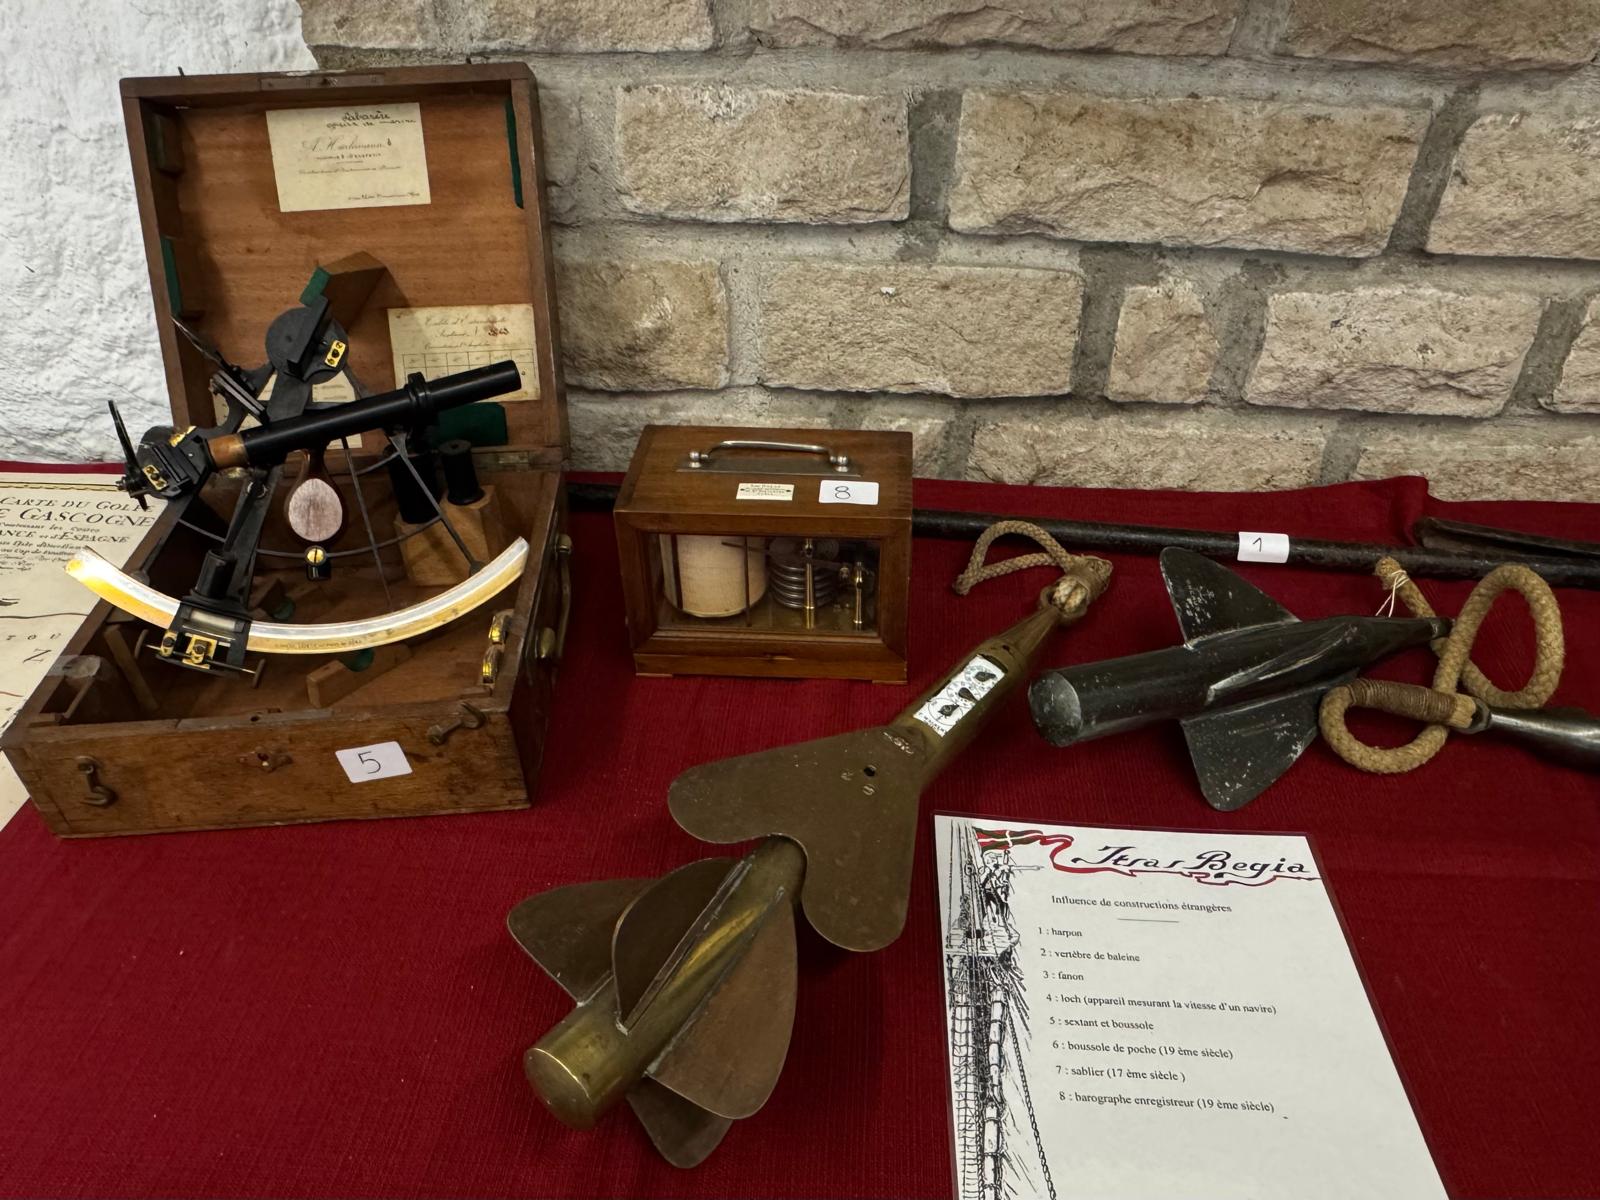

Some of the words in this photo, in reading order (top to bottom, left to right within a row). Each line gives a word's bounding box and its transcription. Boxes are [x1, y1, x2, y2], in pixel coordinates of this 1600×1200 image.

[835, 485, 851, 500] 8
[61, 500, 91, 508] DU
[20, 507, 155, 528] GASCOGNE
[1253, 537, 1262, 552] 1
[358, 750, 382, 775] 5
[1184, 850, 1310, 879] Begia
[1052, 895, 1097, 905] Influence
[1100, 898, 1111, 907] de
[1114, 899, 1179, 910] constructions
[1181, 902, 1232, 913] étrangères
[1051, 928, 1083, 938] harpon
[1054, 950, 1091, 959] vertèbre
[1094, 952, 1105, 960] de
[1107, 952, 1140, 962] baleine
[1058, 971, 1084, 982] fanon
[1061, 994, 1081, 1003] loch
[1083, 995, 1125, 1007] (appareil
[1128, 1000, 1171, 1008] mesurant
[1173, 1000, 1182, 1008] la
[1184, 1001, 1216, 1010] vitesse
[1219, 1002, 1241, 1012] d'un
[1243, 1004, 1276, 1015] navire)
[1064, 1017, 1098, 1027] sextant
[1100, 1020, 1110, 1028] et
[1111, 1020, 1154, 1030] boussole
[1067, 1041, 1110, 1051] boussole
[1113, 1043, 1125, 1052] de
[1127, 1045, 1156, 1055] poche
[1158, 1045, 1175, 1056] (19
[1177, 1047, 1198, 1056] ème
[1201, 1048, 1233, 1060] siècle)
[1071, 1066, 1104, 1077] sablier
[1107, 1069, 1122, 1079] (17
[1126, 1070, 1147, 1079] ème
[1150, 1071, 1178, 1080] siècle
[1075, 1092, 1132, 1105] barographe
[1134, 1096, 1194, 1108] enregistreur
[1197, 1098, 1214, 1110] (19
[1217, 1099, 1238, 1110] ème
[1241, 1101, 1274, 1113] siècle)
